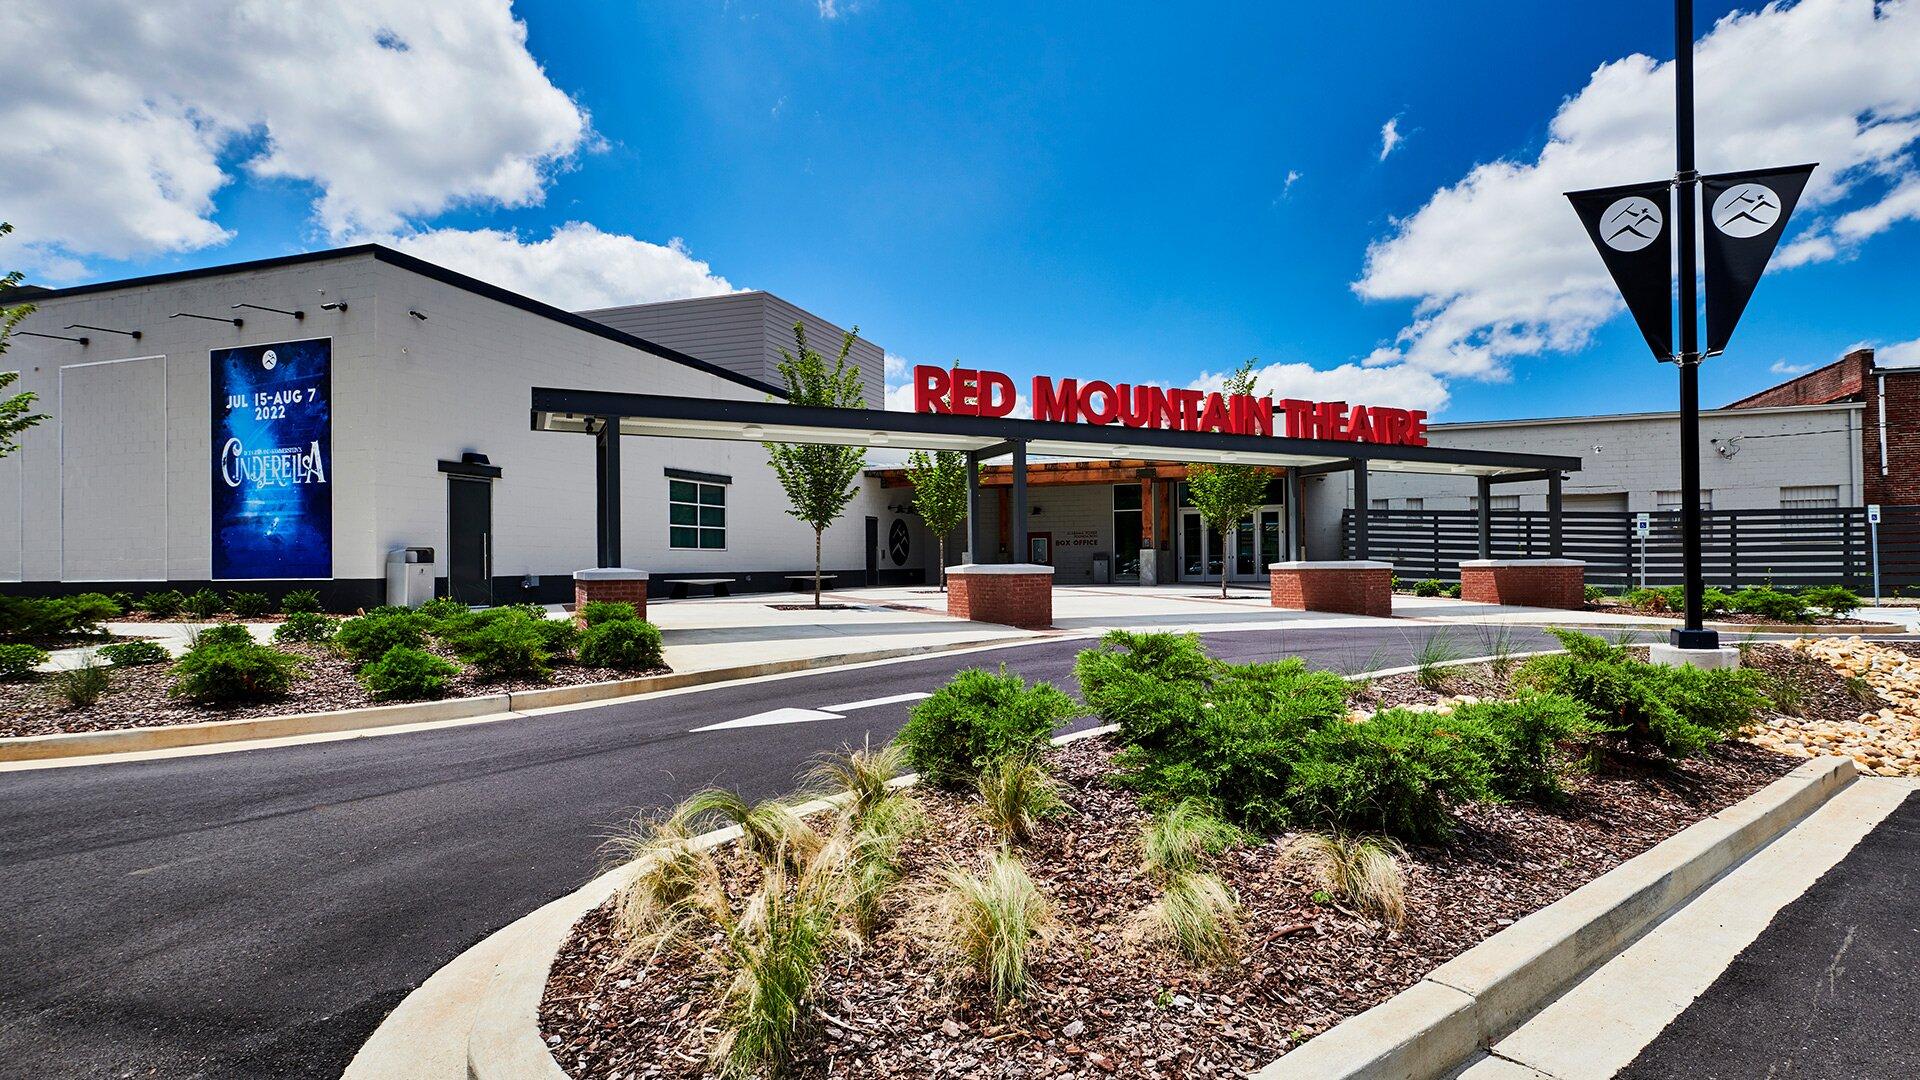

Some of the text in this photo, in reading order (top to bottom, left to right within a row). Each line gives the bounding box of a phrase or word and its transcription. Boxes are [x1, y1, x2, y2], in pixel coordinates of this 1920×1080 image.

[226, 388, 316, 409] JUL 15-AUG 7
[255, 406, 285, 420] 2022
[914, 365, 1428, 446] RED MOUNTAIN THEATRE
[222, 438, 326, 488] CINDERELLA
